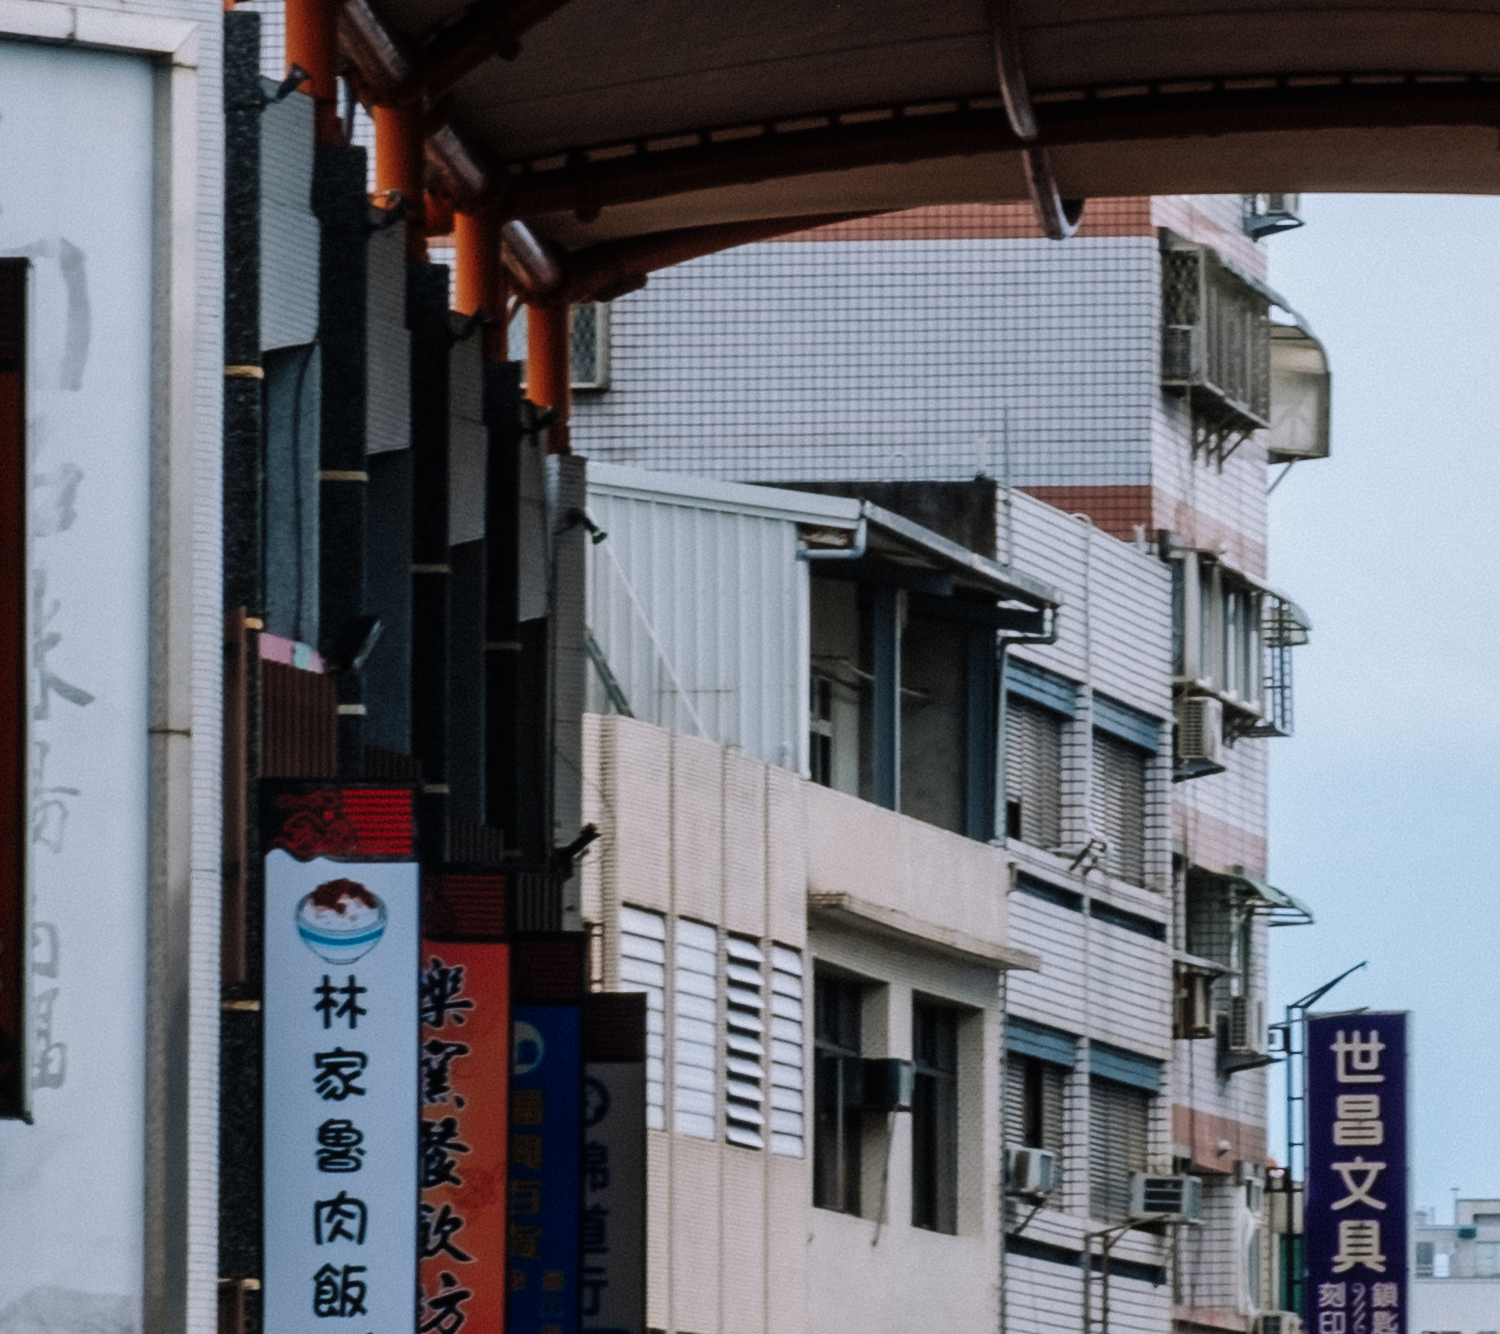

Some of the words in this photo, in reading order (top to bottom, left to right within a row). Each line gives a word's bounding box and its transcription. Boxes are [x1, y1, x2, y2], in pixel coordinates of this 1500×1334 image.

[313, 974, 369, 1320] 林家魯肉飯
